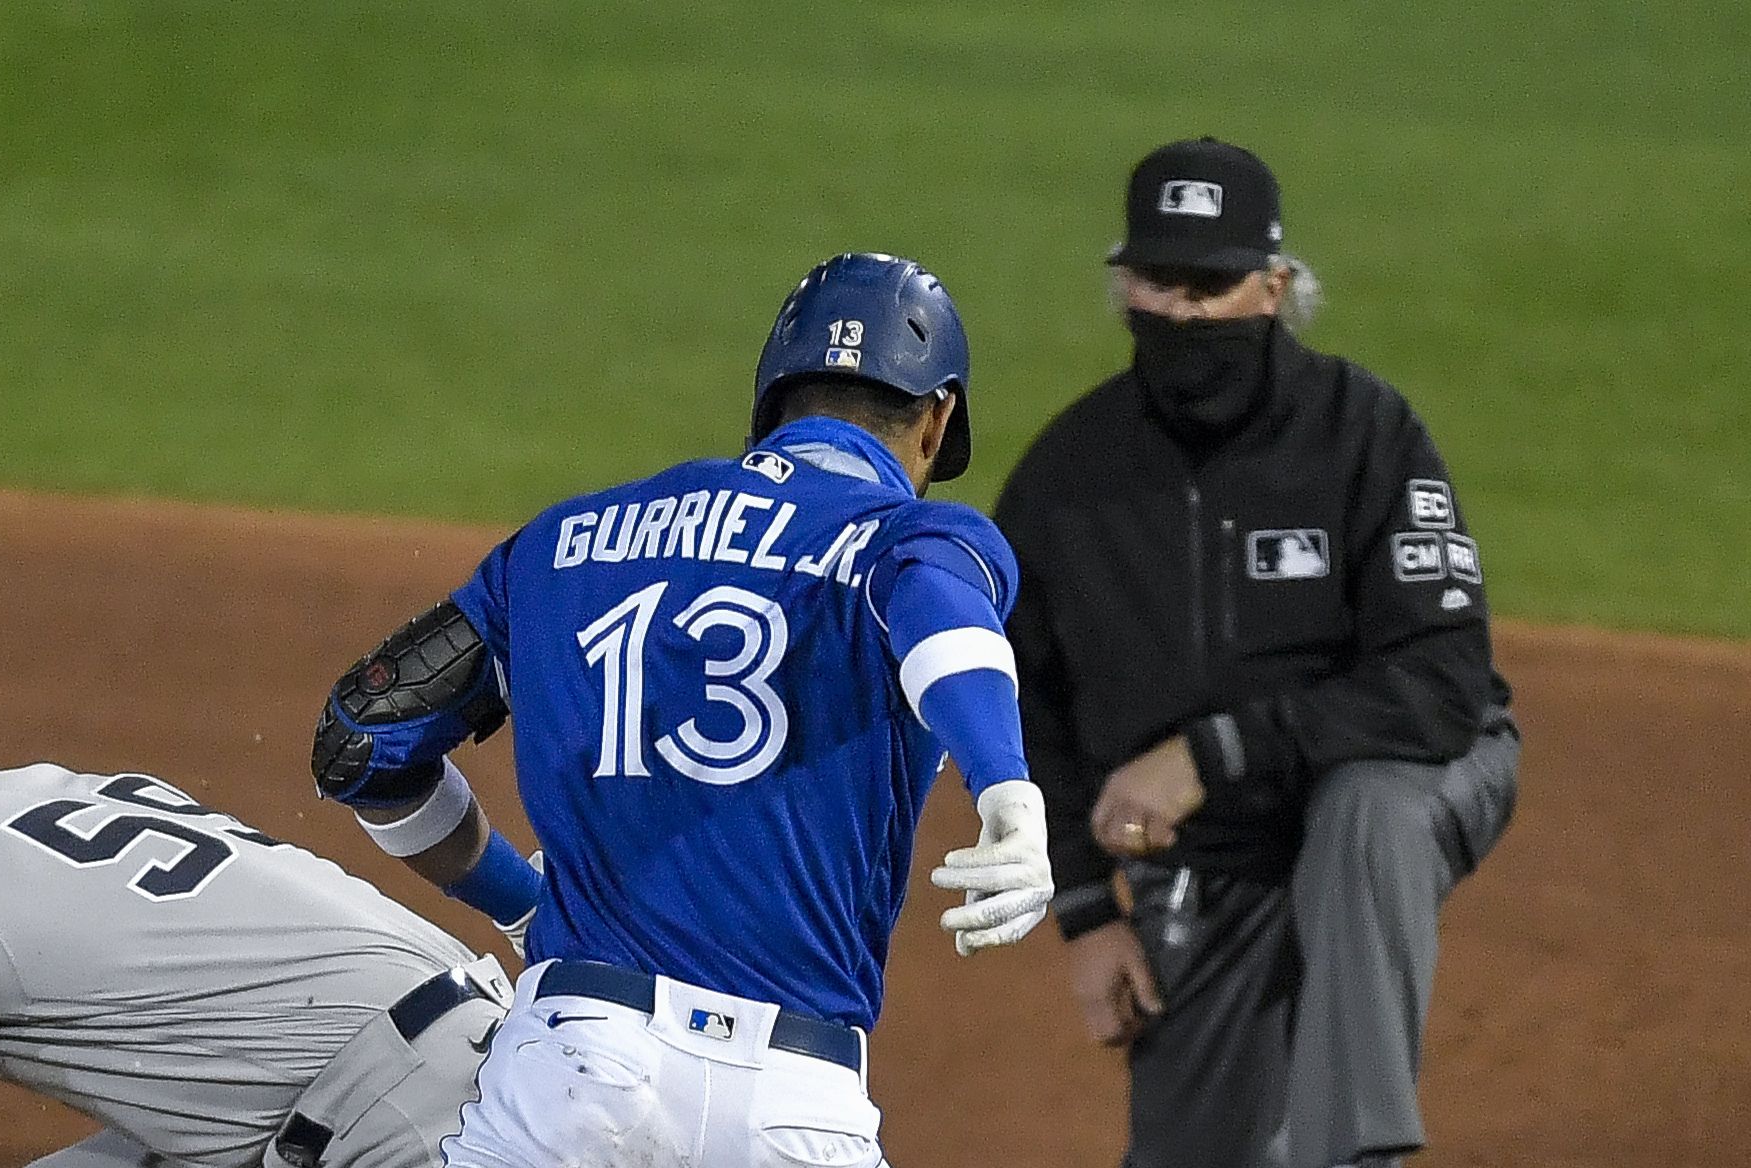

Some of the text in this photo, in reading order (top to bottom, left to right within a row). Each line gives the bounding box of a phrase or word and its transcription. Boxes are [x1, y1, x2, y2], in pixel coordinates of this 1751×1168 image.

[828, 319, 864, 346] 13
[553, 489, 798, 571] GURRIEL
[575, 580, 790, 786] 13
